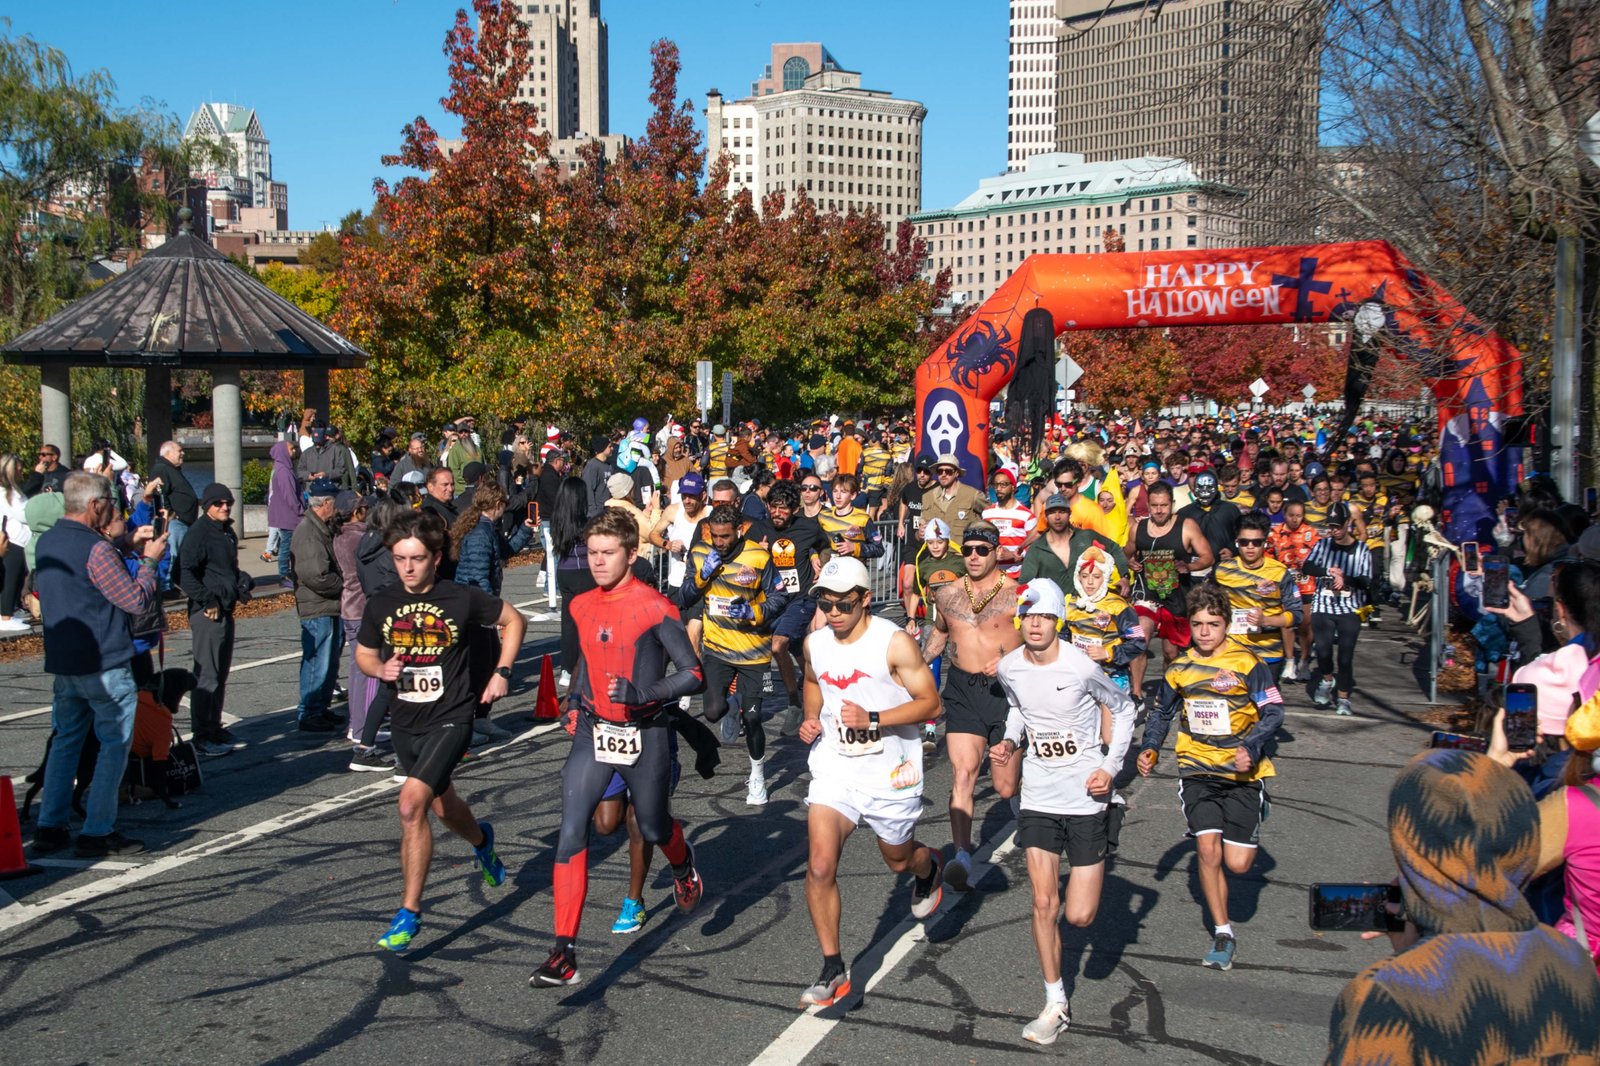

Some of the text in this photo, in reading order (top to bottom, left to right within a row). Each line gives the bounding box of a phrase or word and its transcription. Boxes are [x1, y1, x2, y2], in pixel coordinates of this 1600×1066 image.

[1144, 261, 1263, 288] HAPPY
[395, 602, 444, 617] CRYSTAL
[410, 646, 444, 655] PLACE
[396, 677, 441, 693] 1109
[1194, 711, 1219, 719] JOSEPH
[596, 734, 640, 755] 1621
[1032, 740, 1077, 758] 1396
